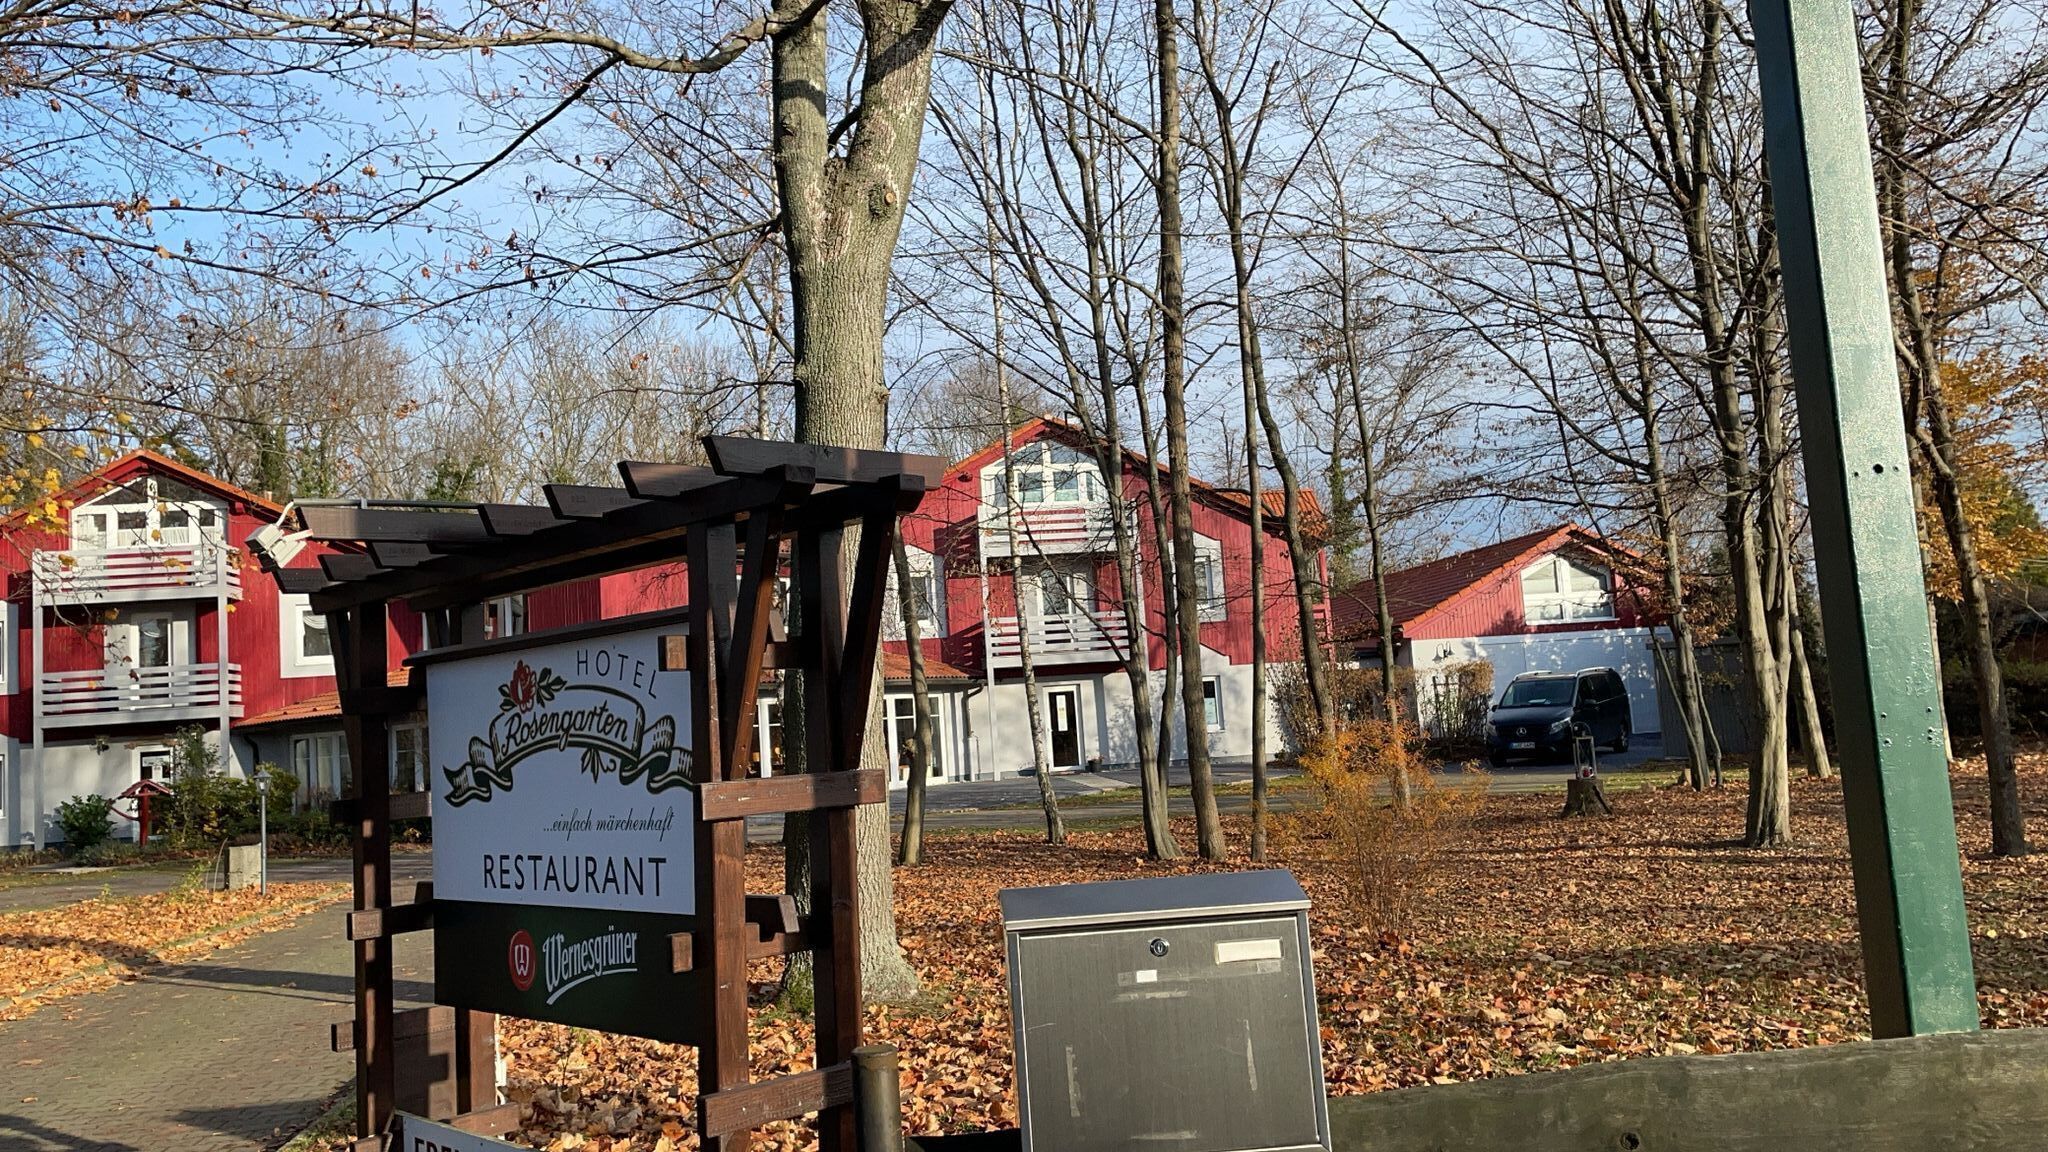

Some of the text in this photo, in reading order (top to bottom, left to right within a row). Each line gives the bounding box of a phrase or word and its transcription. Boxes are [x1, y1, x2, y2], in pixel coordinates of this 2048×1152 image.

[576, 649, 657, 699] HOTEL
[502, 701, 628, 752] Rosengarten
[543, 806, 675, 842] ...einfach märchenhaft
[483, 854, 667, 897] RESTAURANT
[542, 925, 638, 993] Wernesgrüner
